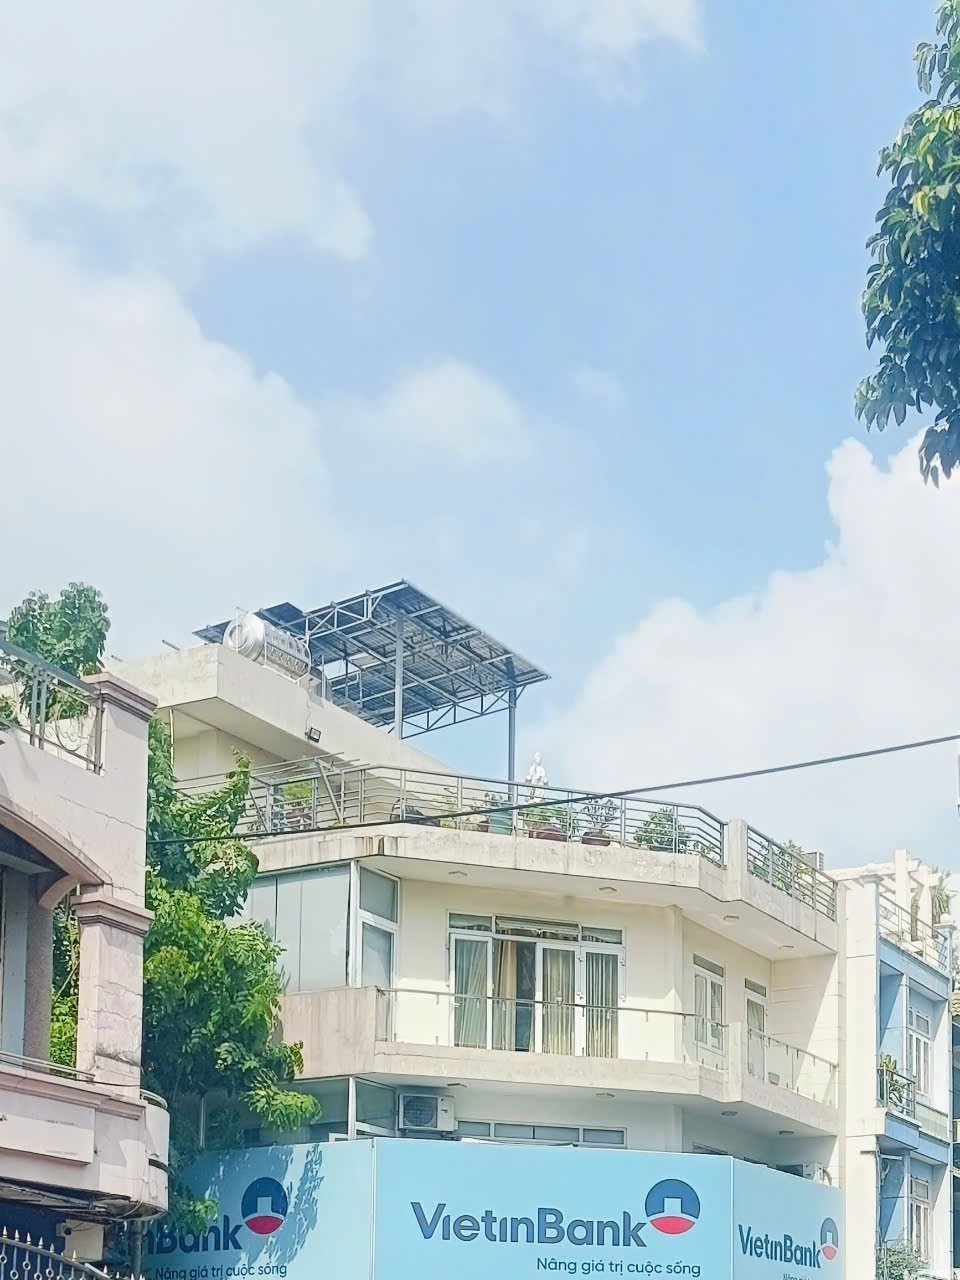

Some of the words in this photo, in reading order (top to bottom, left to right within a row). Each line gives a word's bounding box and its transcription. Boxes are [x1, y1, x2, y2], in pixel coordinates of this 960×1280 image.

[410, 1201, 647, 1248] VietinBank
[738, 1224, 821, 1268] VietinBank
[189, 1265, 208, 1279] giá
[211, 1264, 224, 1280] trị
[226, 1263, 255, 1279] cuộc
[258, 1260, 287, 1277] sống
[537, 1257, 577, 1274] Nâng
[581, 1259, 604, 1274] giá
[608, 1261, 624, 1276] trị
[627, 1261, 662, 1277] cuộc
[666, 1260, 701, 1277] sống
